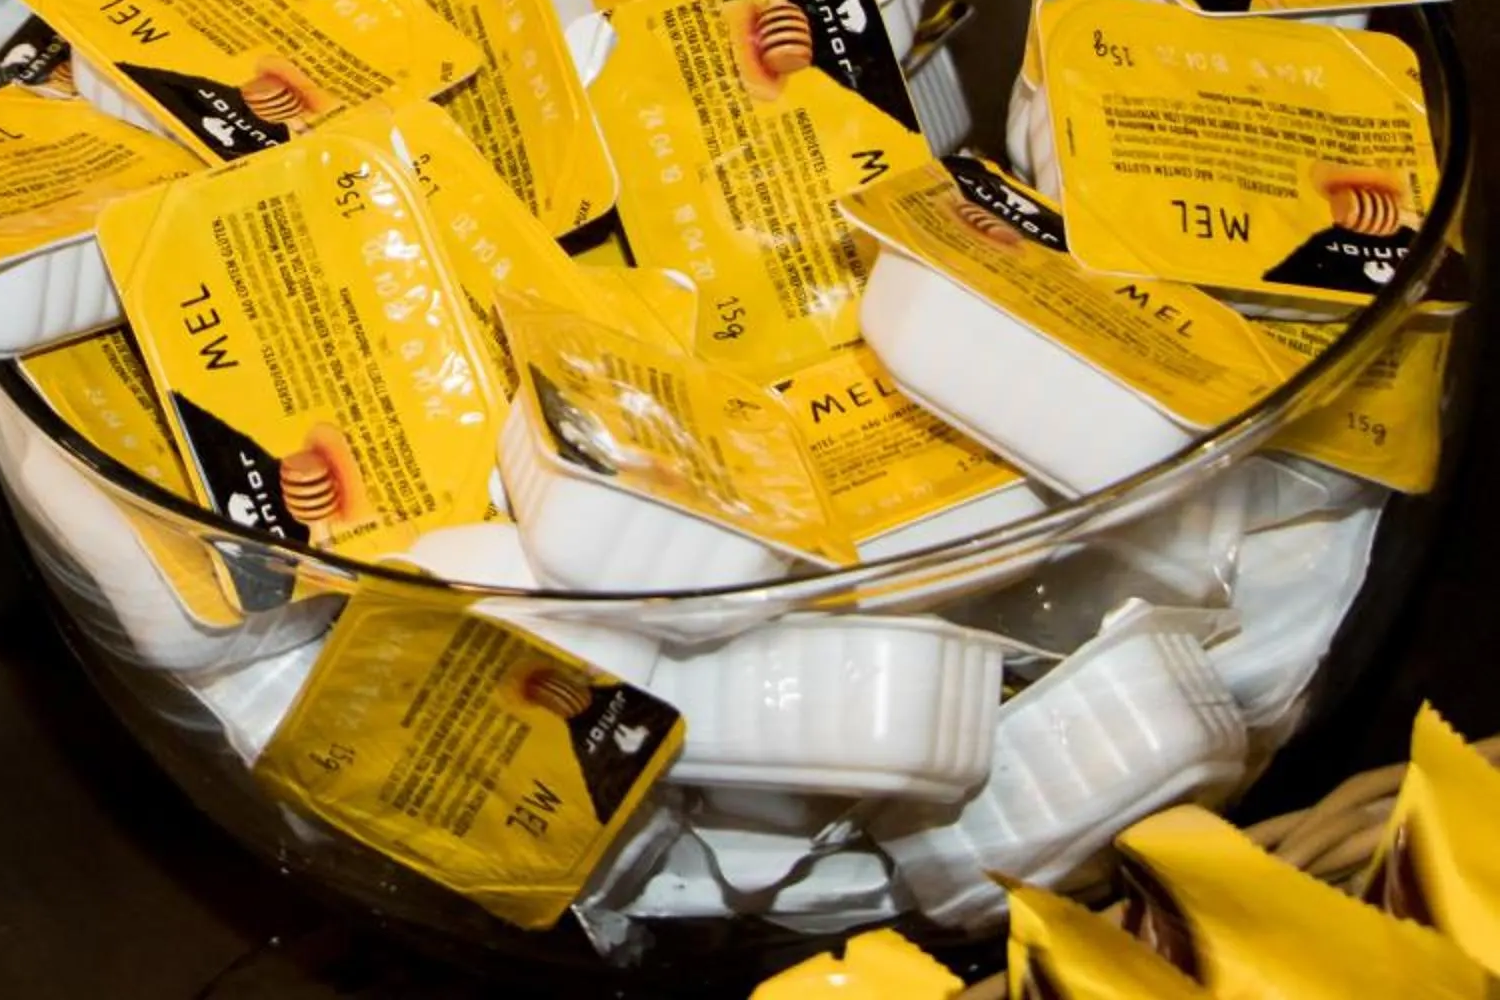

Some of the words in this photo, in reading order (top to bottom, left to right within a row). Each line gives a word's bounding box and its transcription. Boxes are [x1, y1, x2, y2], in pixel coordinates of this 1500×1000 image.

[1092, 29, 1135, 67] 15g
[336, 166, 372, 219] 15g
[951, 176, 1058, 242] JUNIOR
[1171, 199, 1250, 243] MEL
[1326, 242, 1409, 259] UNIOR
[180, 283, 239, 371] MEL
[712, 296, 746, 341] 15g
[1114, 284, 1192, 338] MEL
[810, 377, 899, 424] MEL
[1342, 407, 1388, 447] 15g
[239, 451, 285, 539] UNIOR
[586, 691, 625, 754] JUNIOR
[308, 743, 355, 775] 15g
[505, 779, 562, 839] MEL
